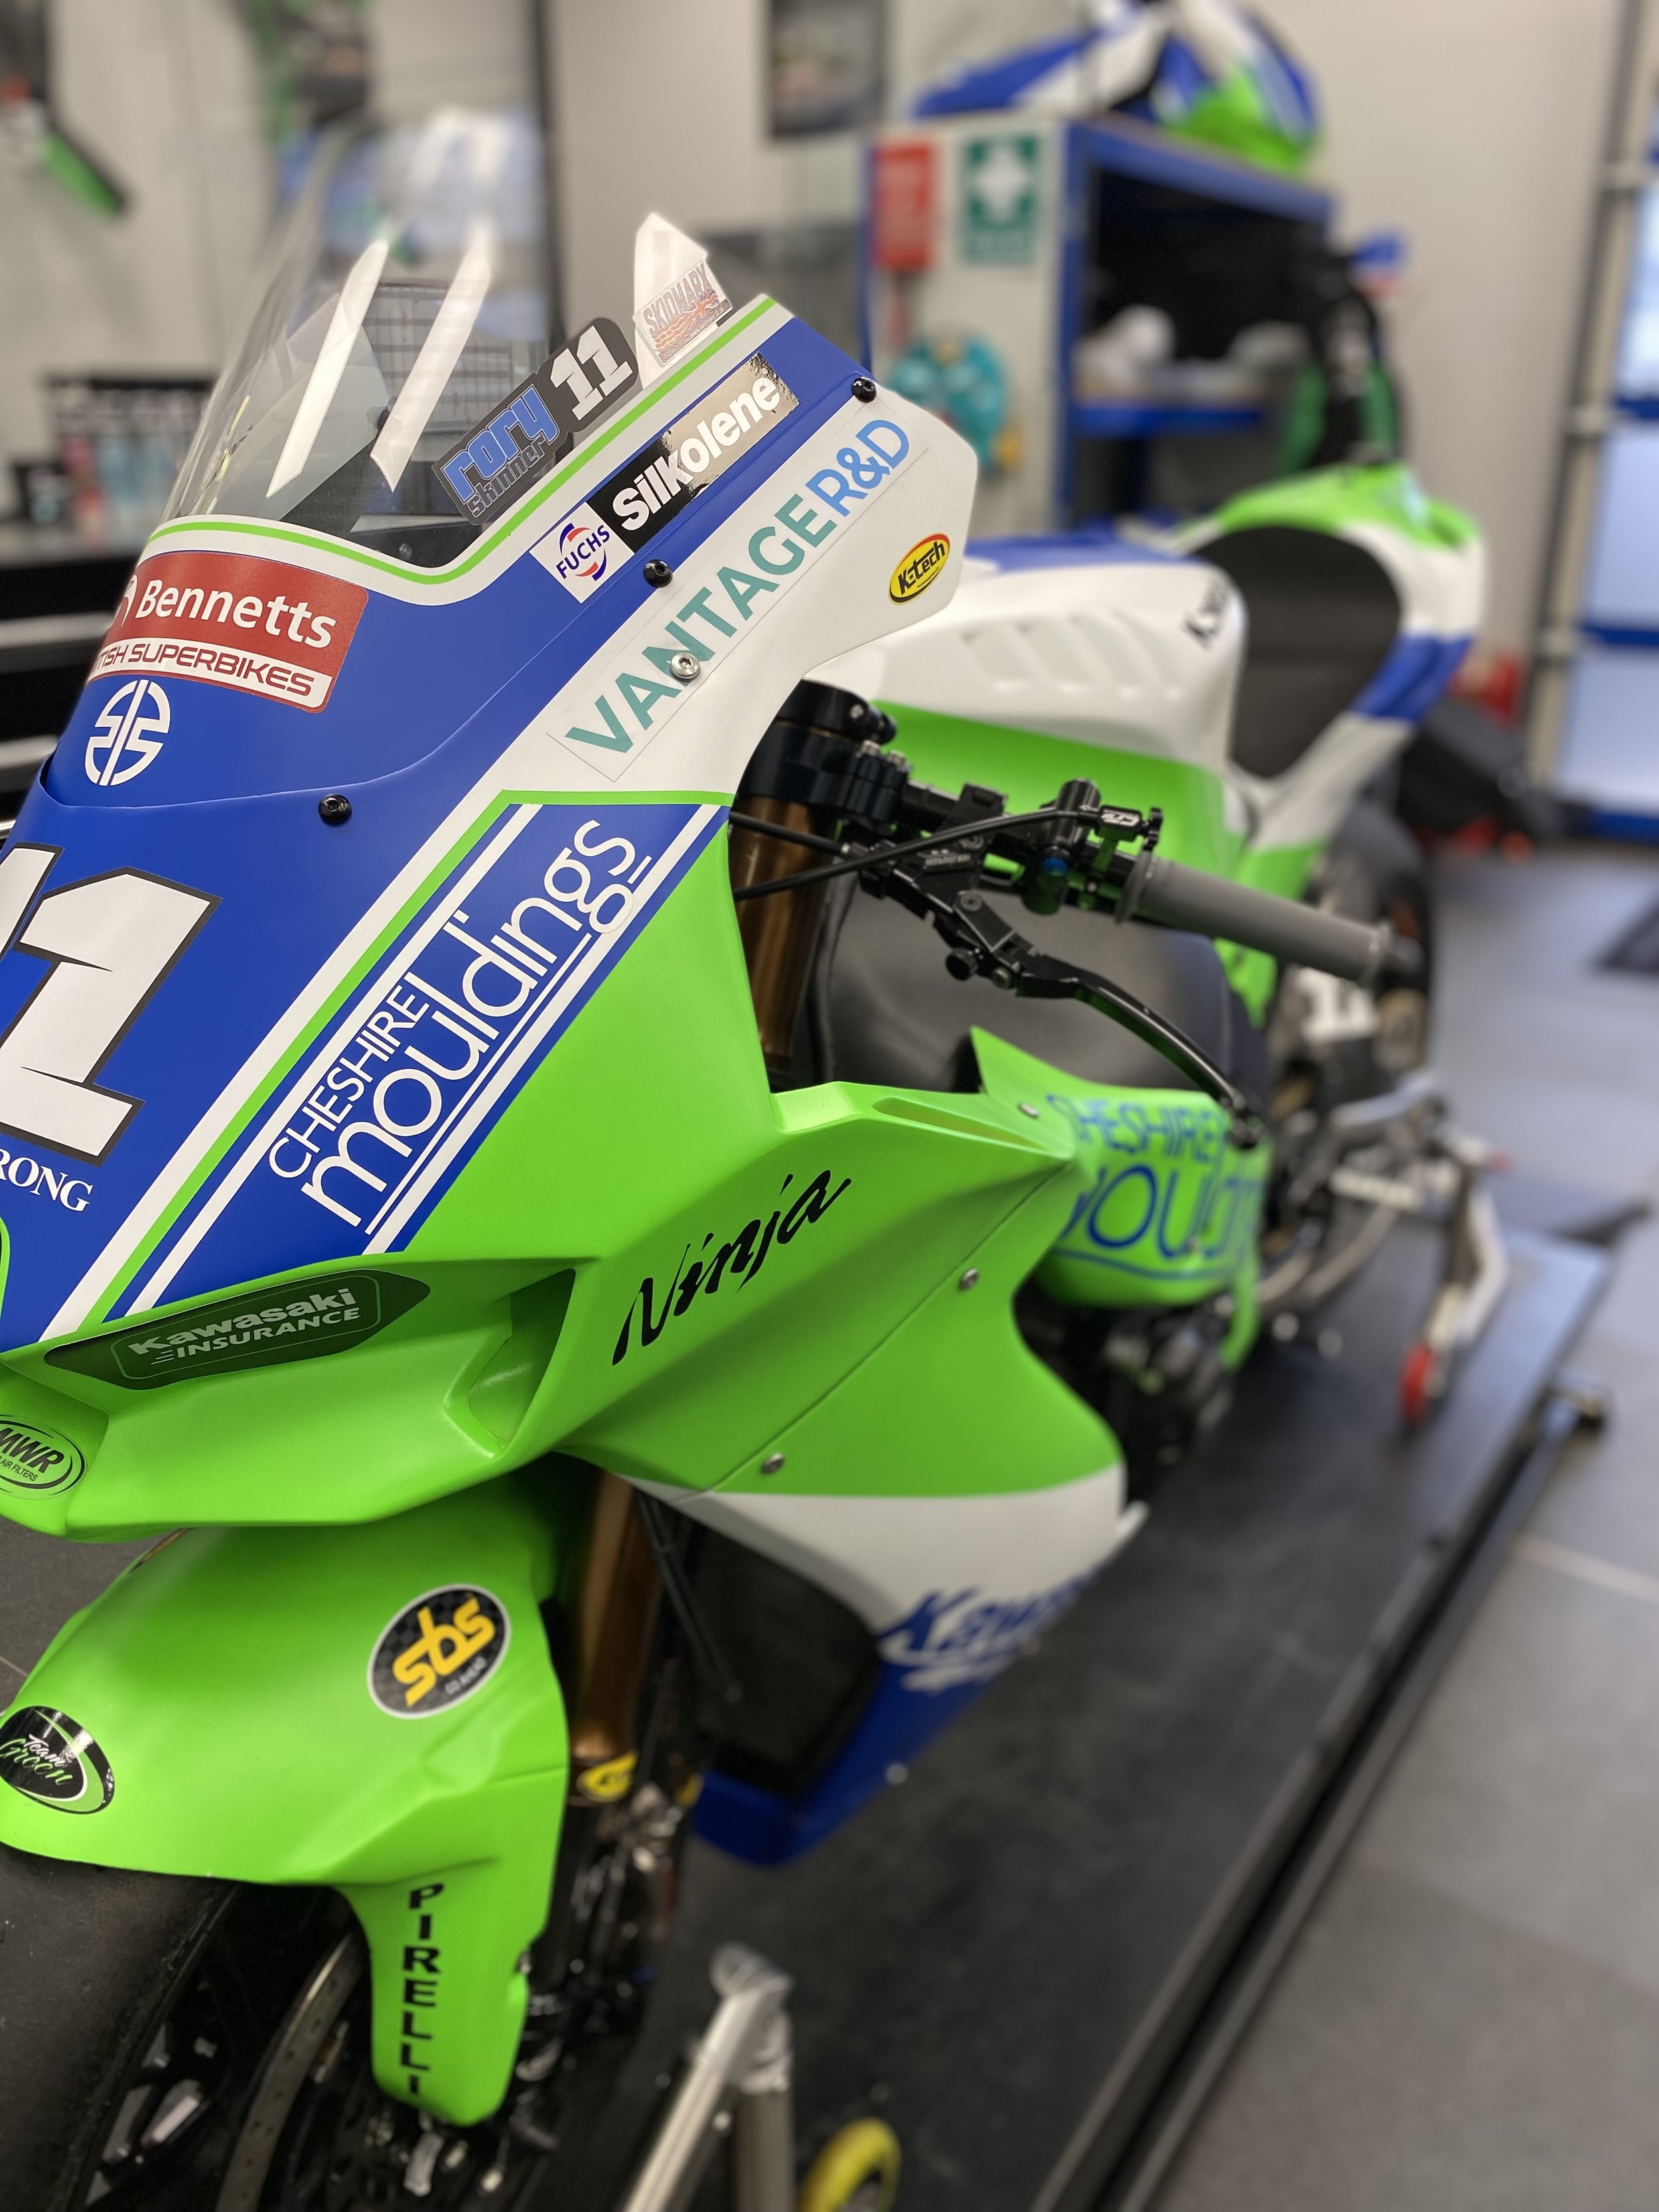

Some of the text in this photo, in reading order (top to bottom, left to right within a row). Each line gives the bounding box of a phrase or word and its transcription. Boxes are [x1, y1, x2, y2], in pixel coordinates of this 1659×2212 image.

[549, 325, 634, 421] 11
[441, 384, 559, 504] rory
[467, 433, 547, 518] skinner
[612, 376, 780, 531] Silkolene
[555, 524, 611, 579] FUCHS
[135, 579, 337, 649] Bennetts
[127, 643, 315, 697] SUPERBIKES
[301, 819, 636, 1228] mouldings
[268, 984, 431, 1178] CHESHIRE
[612, 1169, 852, 1366] Ninja
[127, 1288, 357, 1355] Kawasaki
[177, 1307, 361, 1358] INSURANCE
[11, 1463, 38, 1481] FILTERS
[392, 1595, 496, 1708] sbs
[0, 1738, 73, 1785] Green
[24, 1733, 72, 1767] Team
[400, 1883, 445, 2094] PIRELLI
